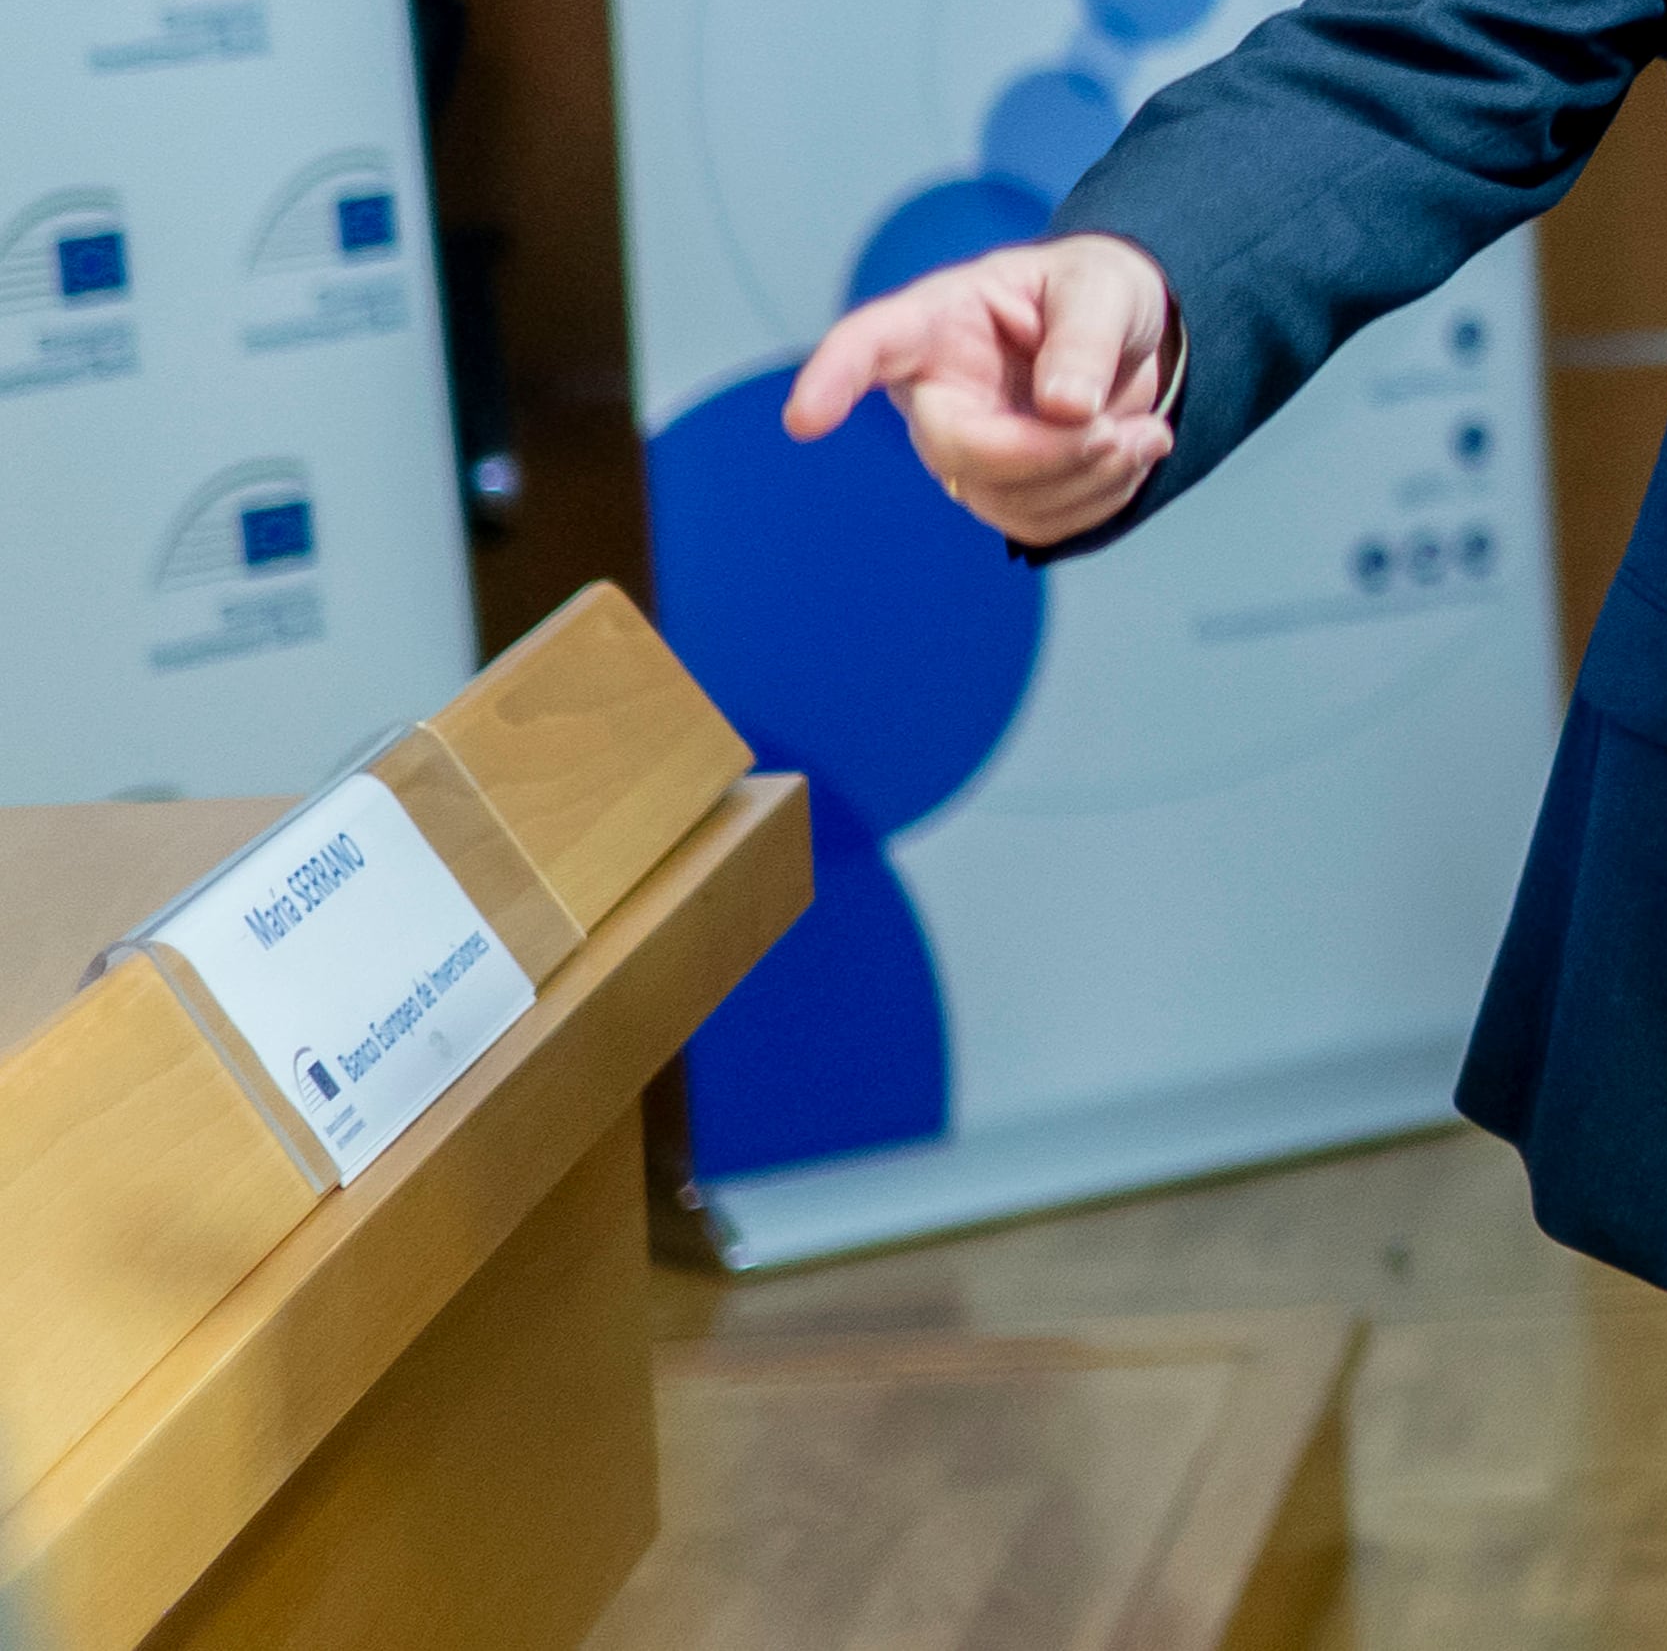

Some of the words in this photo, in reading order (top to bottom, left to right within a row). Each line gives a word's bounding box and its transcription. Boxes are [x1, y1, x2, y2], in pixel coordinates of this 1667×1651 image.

[244, 886, 303, 951] María
[286, 833, 365, 913] SERRANO
[424, 930, 490, 995] Inversiones
[413, 977, 438, 1009] de
[369, 995, 424, 1051] Europeo
[337, 1037, 382, 1083] Banco
